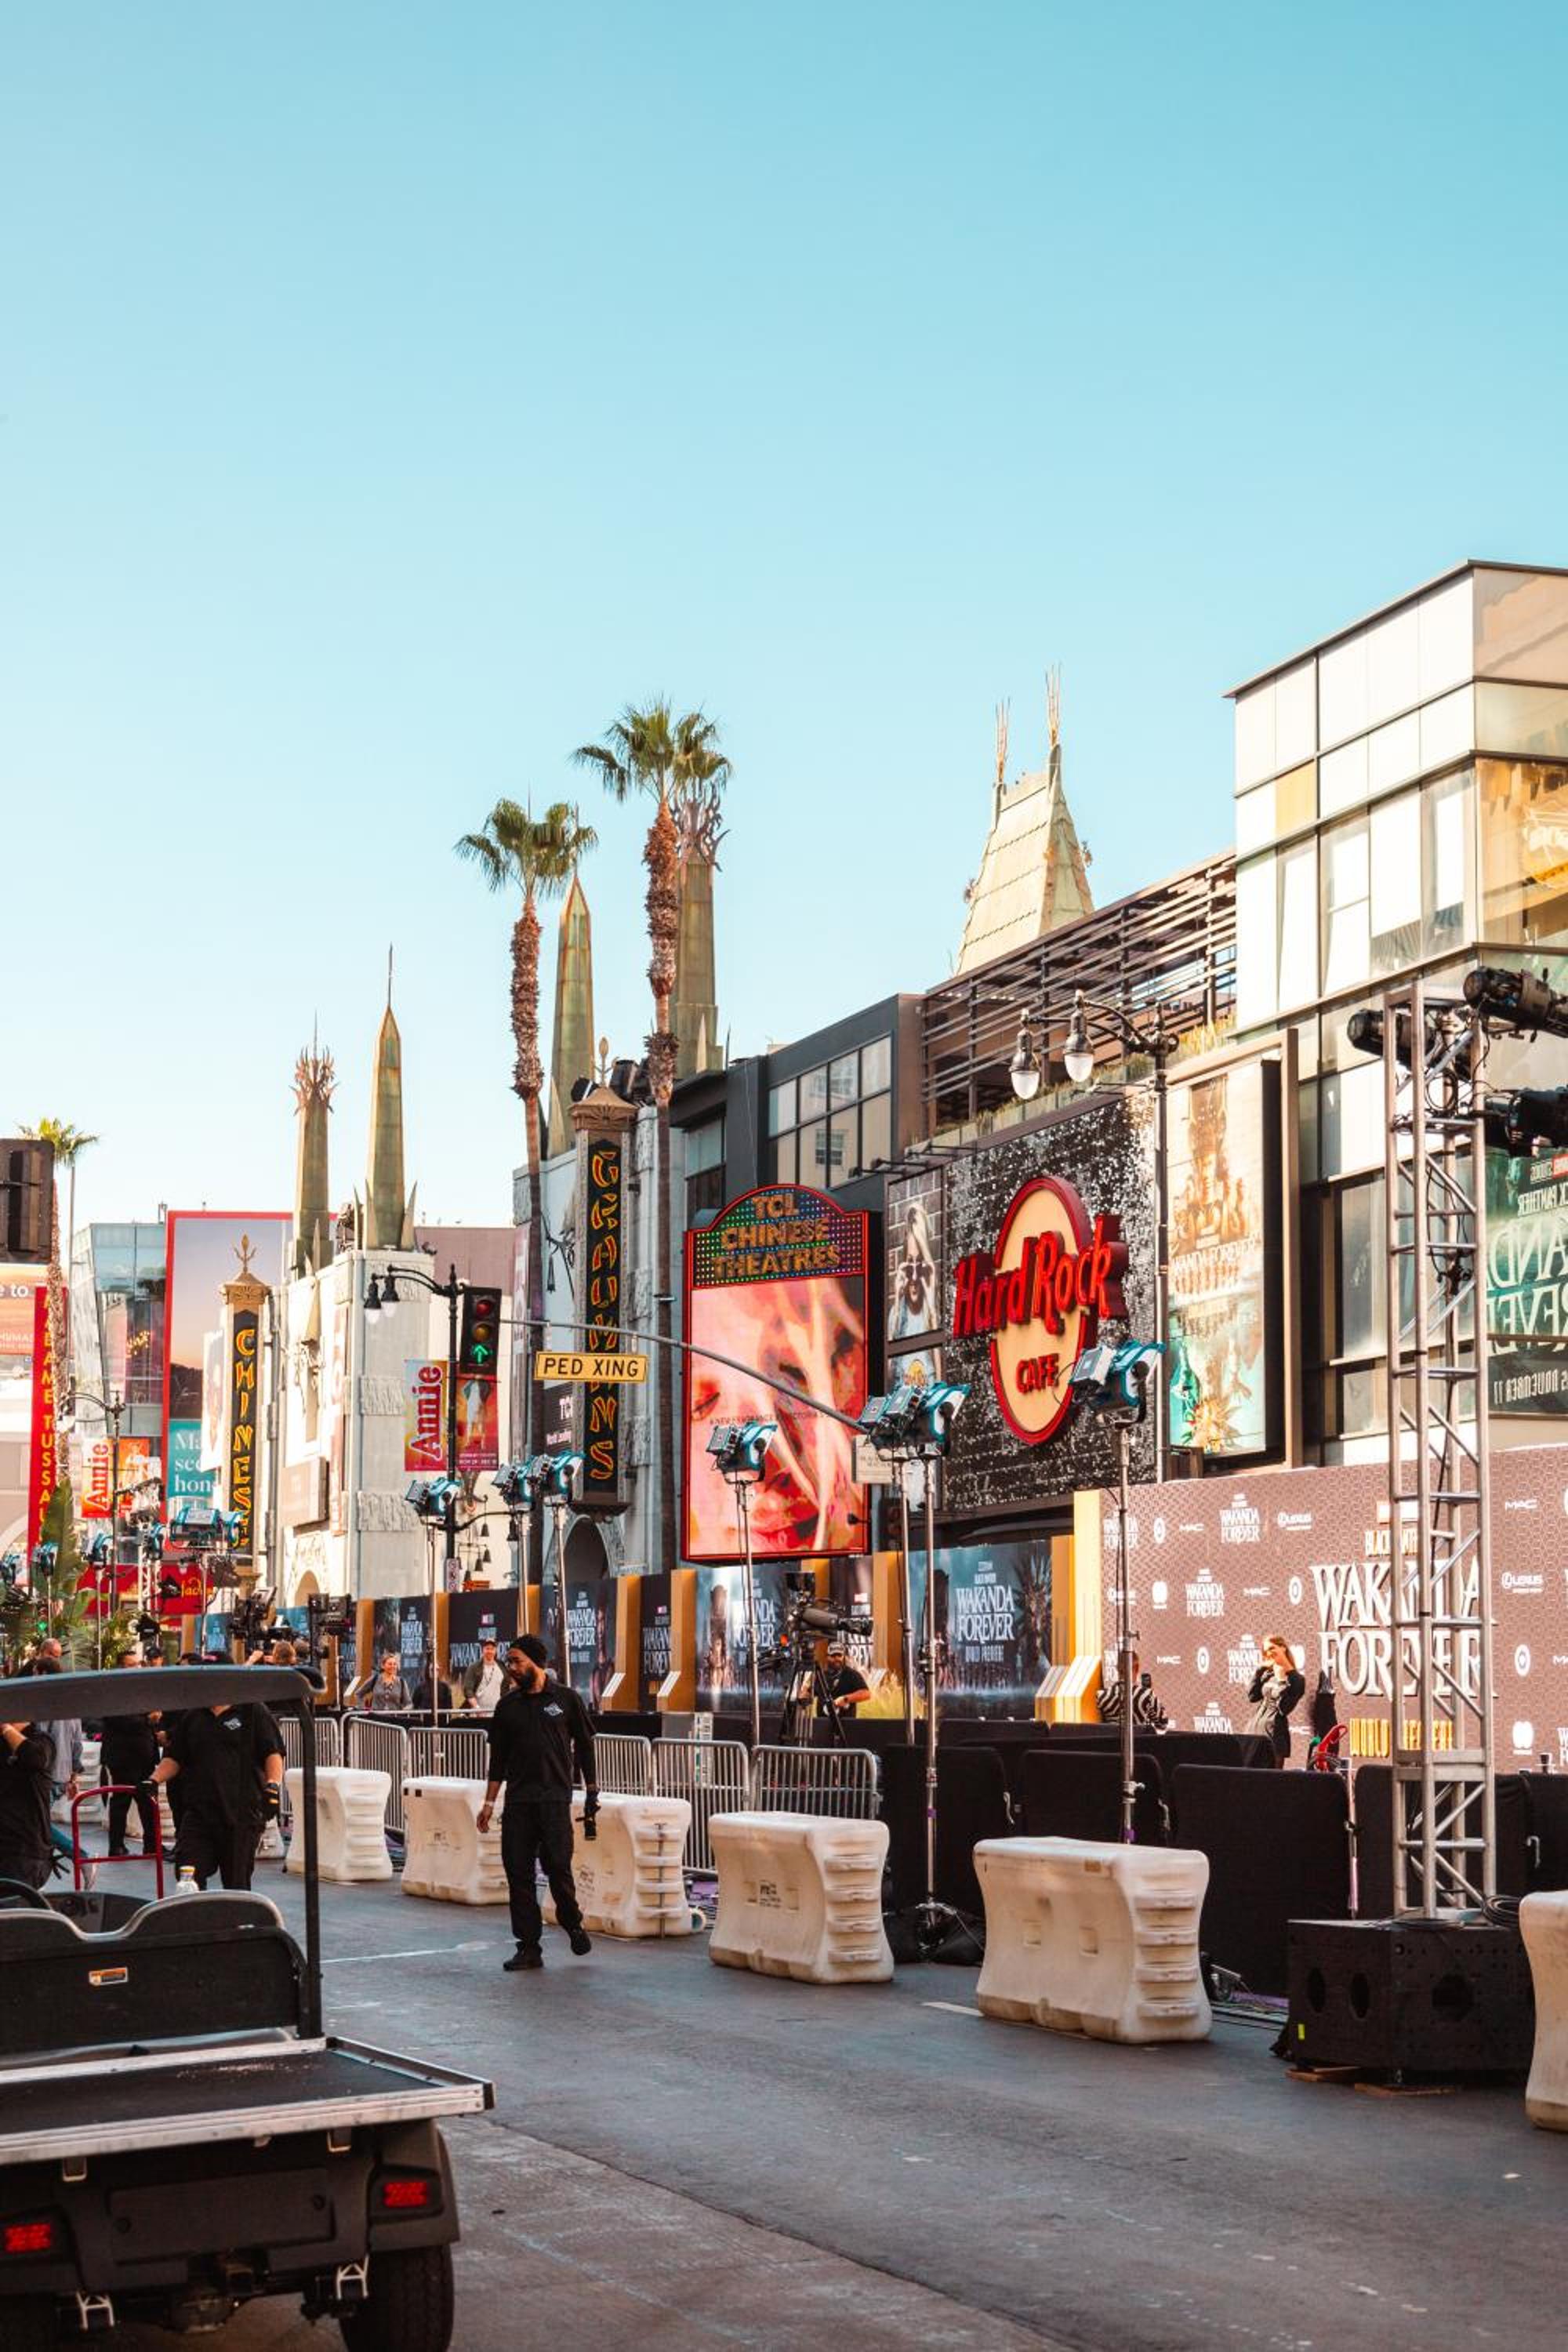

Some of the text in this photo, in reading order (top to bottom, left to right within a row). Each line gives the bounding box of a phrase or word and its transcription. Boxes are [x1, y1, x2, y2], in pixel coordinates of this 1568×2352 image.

[752, 1193, 799, 1220] TCL
[720, 1217, 830, 1251] CHINESE
[713, 1243, 841, 1279] THEATRES
[953, 1214, 1123, 1339] Hard Rock
[11, 1284, 29, 1298] to
[590, 1150, 619, 1480] GRAUMNS
[543, 1357, 639, 1377] PED XING
[1016, 1353, 1059, 1394] CAFE
[410, 1366, 442, 1461] Annie
[85, 1443, 110, 1512] Annie
[956, 1584, 1015, 1613] WAKANDA
[1308, 1556, 1498, 1632] WAKA
[957, 1613, 1015, 1644] FOREVER
